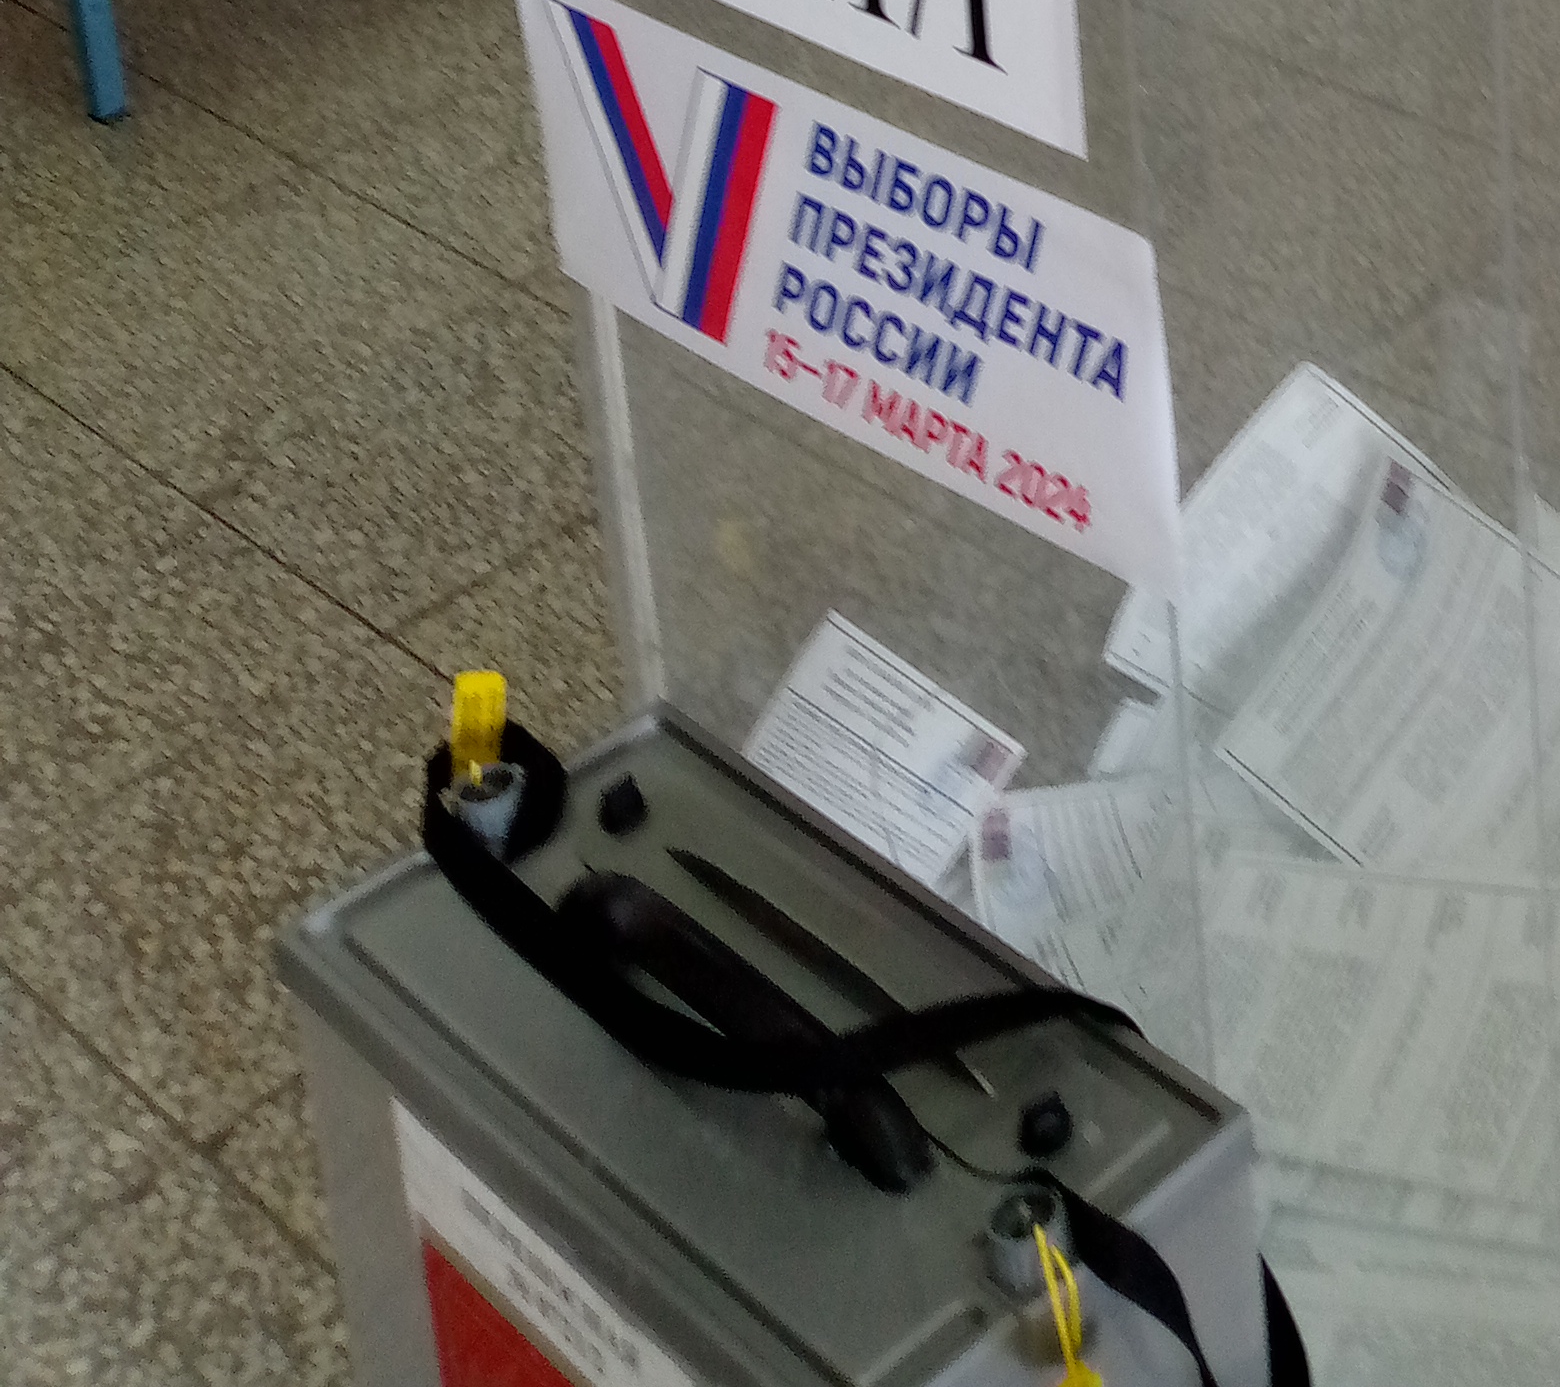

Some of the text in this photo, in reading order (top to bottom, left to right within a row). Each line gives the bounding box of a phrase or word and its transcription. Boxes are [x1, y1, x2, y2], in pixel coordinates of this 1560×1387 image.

[806, 119, 1049, 275] ВЫБОРЫ
[772, 261, 984, 407] РОССИИ
[788, 194, 1130, 404] ПРЕЗИДЕНТА
[860, 379, 991, 484] МАРТА
[995, 448, 1094, 533] 2024
